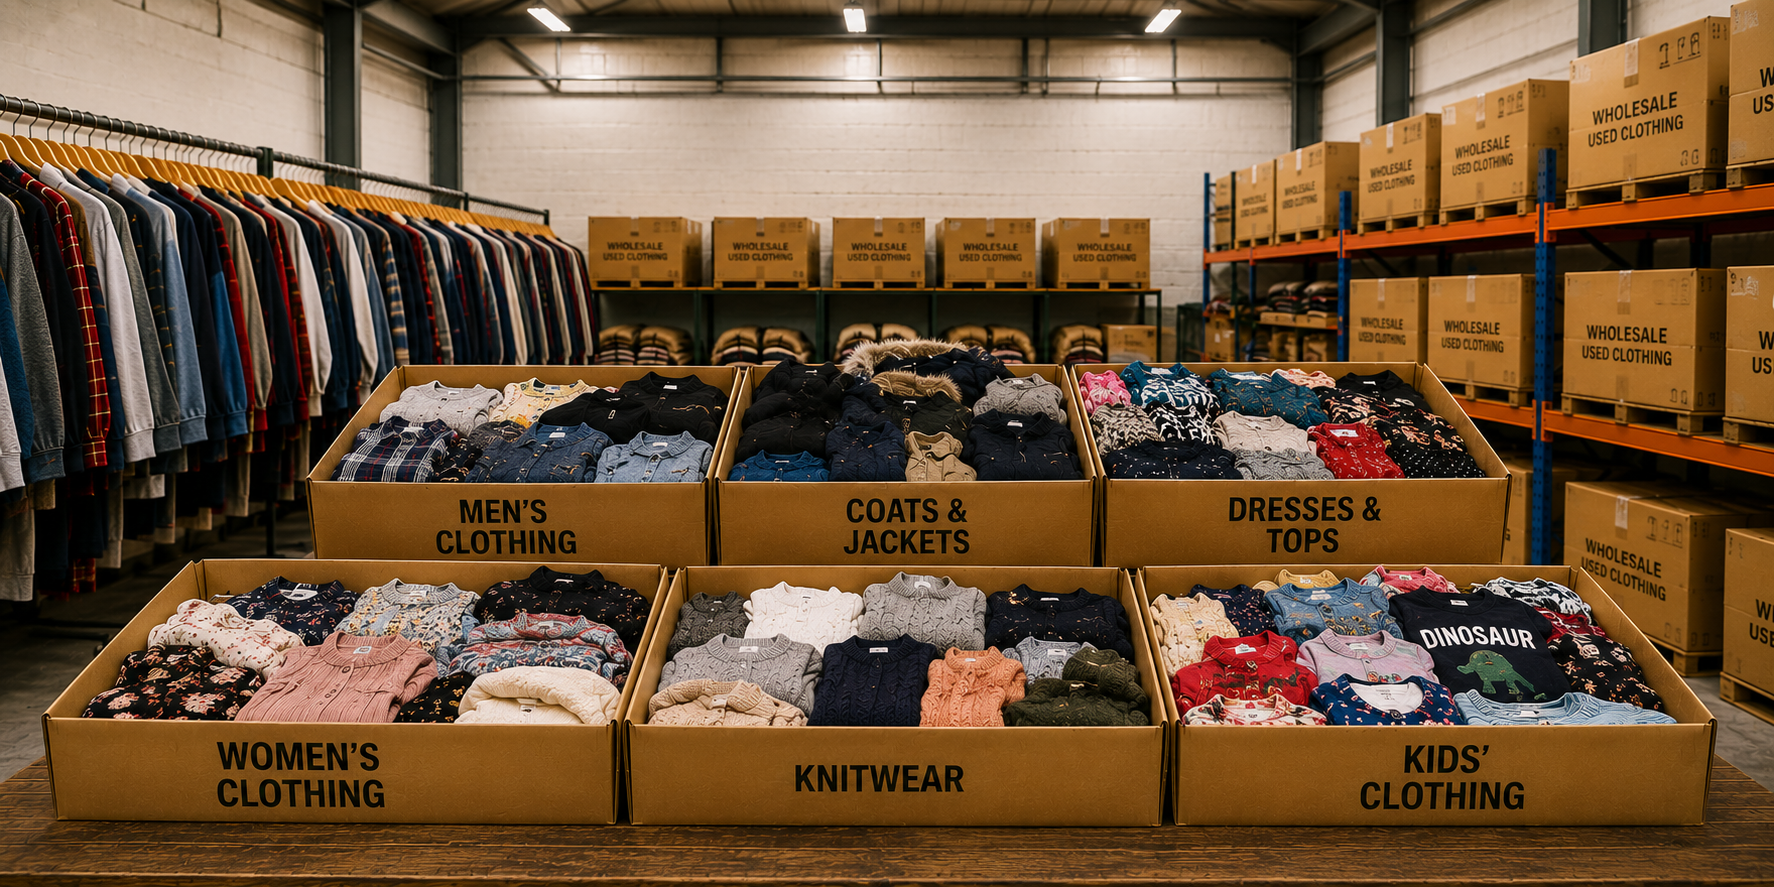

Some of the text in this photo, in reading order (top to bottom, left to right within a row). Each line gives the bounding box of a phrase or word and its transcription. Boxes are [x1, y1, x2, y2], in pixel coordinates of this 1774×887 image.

[1592, 91, 1678, 126] WHOLESALE
[1588, 114, 1684, 148] USED CLOTHING
[1454, 134, 1511, 160] WHOLESALE
[1370, 159, 1413, 179] WHOLESALE
[1451, 149, 1514, 176] USED CLOTHING
[1367, 174, 1415, 193] USED CLOTHING
[603, 252, 668, 261] USED CLOTHING
[607, 242, 664, 251] WHOLESALE
[728, 252, 794, 261] USED CLOTHING
[733, 242, 789, 251] WHOLESALE
[851, 242, 907, 251] WHOLESALE
[963, 242, 1018, 251] WHOLESALE
[1077, 242, 1132, 251] WHOLESALE
[847, 253, 911, 262] USED CLOTHING
[959, 253, 1022, 262] USED CLOTHING
[1072, 253, 1137, 262] USED CLOTHING
[1360, 316, 1403, 330] WHOLESALE
[1444, 320, 1500, 335] WHOLESALE
[1358, 331, 1406, 346] USED CLOTHING
[1586, 324, 1667, 344] WHOLESALE
[1441, 337, 1504, 353] USED CLOTHING
[1582, 345, 1672, 366] USED CLOTHING
[459, 498, 547, 524] MEN’S
[846, 498, 968, 523] COATS &
[1228, 496, 1382, 522] DRESSES &
[436, 530, 577, 555] CLOTHING
[843, 529, 970, 555] JACKETS
[1266, 528, 1339, 554] TOPS
[1585, 537, 1662, 579] WHOLESALE
[1581, 556, 1667, 602] USED CLOTHING
[1419, 626, 1536, 651] DINOSAUR
[216, 740, 379, 772] WOMEN’S
[794, 764, 965, 793] KNITWEAR
[216, 778, 386, 809] CLOTHING
[1359, 781, 1526, 811] CLOTHING
